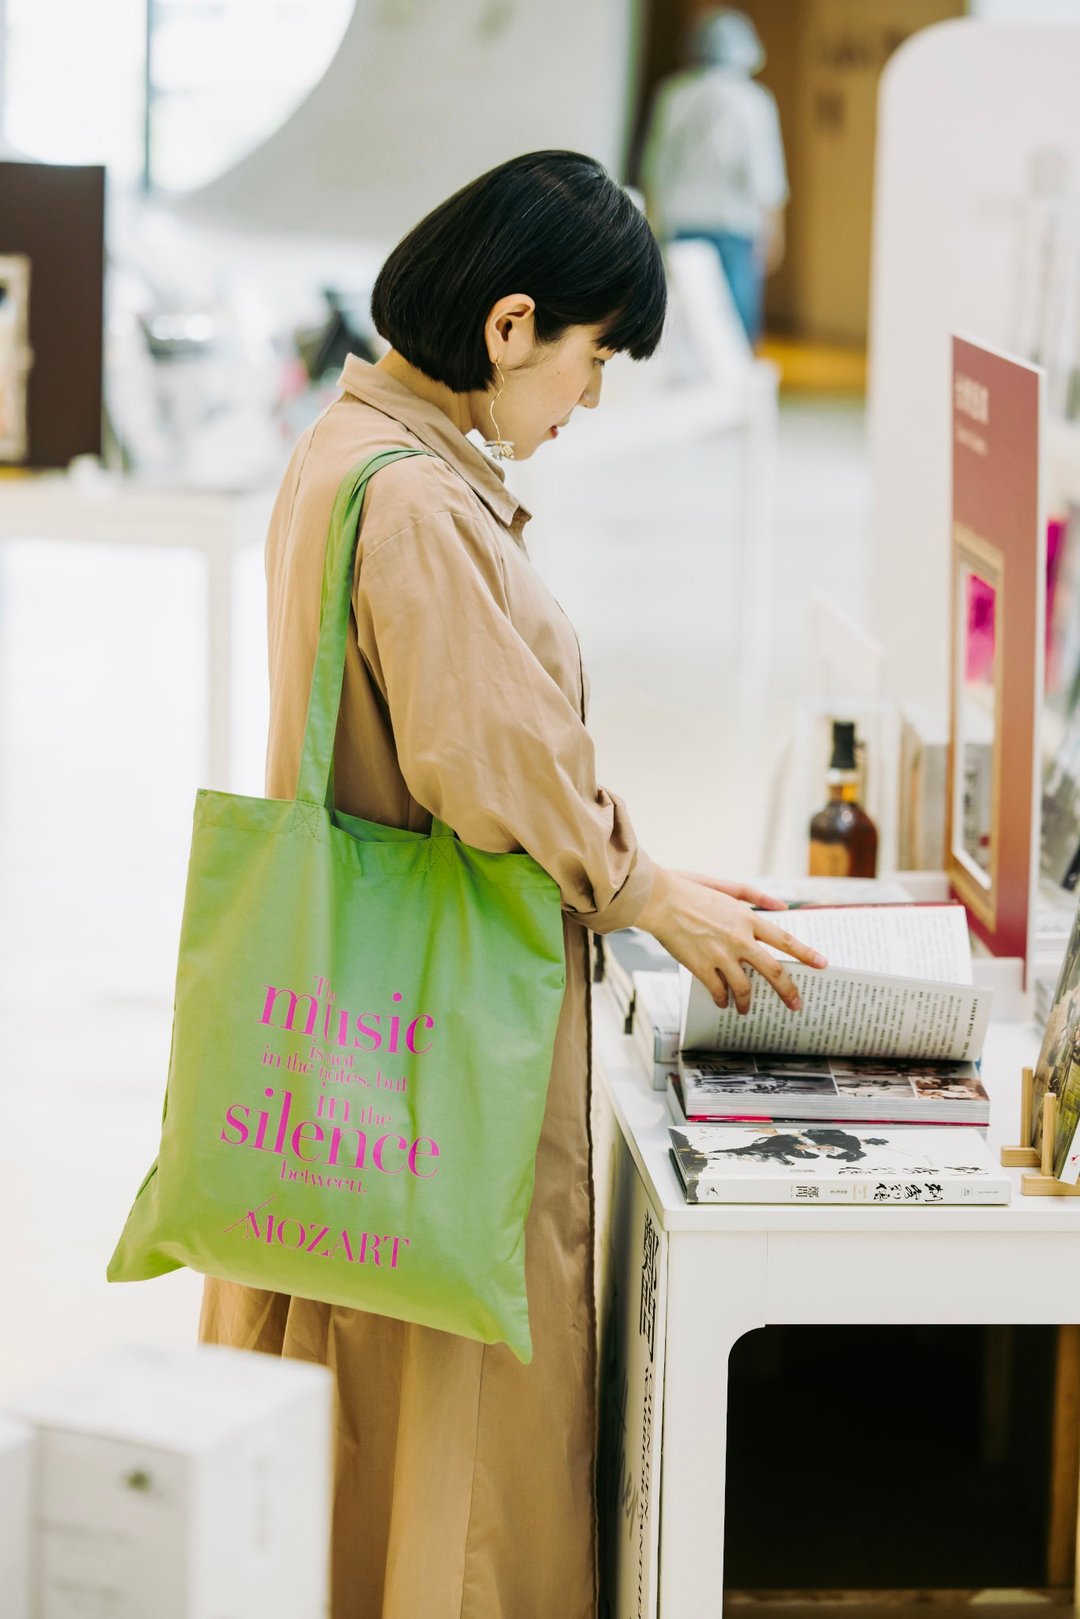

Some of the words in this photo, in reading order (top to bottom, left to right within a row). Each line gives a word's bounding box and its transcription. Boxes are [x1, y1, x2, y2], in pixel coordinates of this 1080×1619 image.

[256, 985, 436, 1055] music
[262, 1044, 281, 1068] in
[287, 1052, 314, 1074] the
[376, 1066, 407, 1093] but
[310, 1038, 324, 1060] is
[326, 1052, 355, 1069] not
[316, 1081, 351, 1123] in
[359, 1105, 394, 1129] the
[219, 1087, 442, 1179] silence
[279, 1159, 368, 1194] between.
[244, 1210, 411, 1269] MOZART
